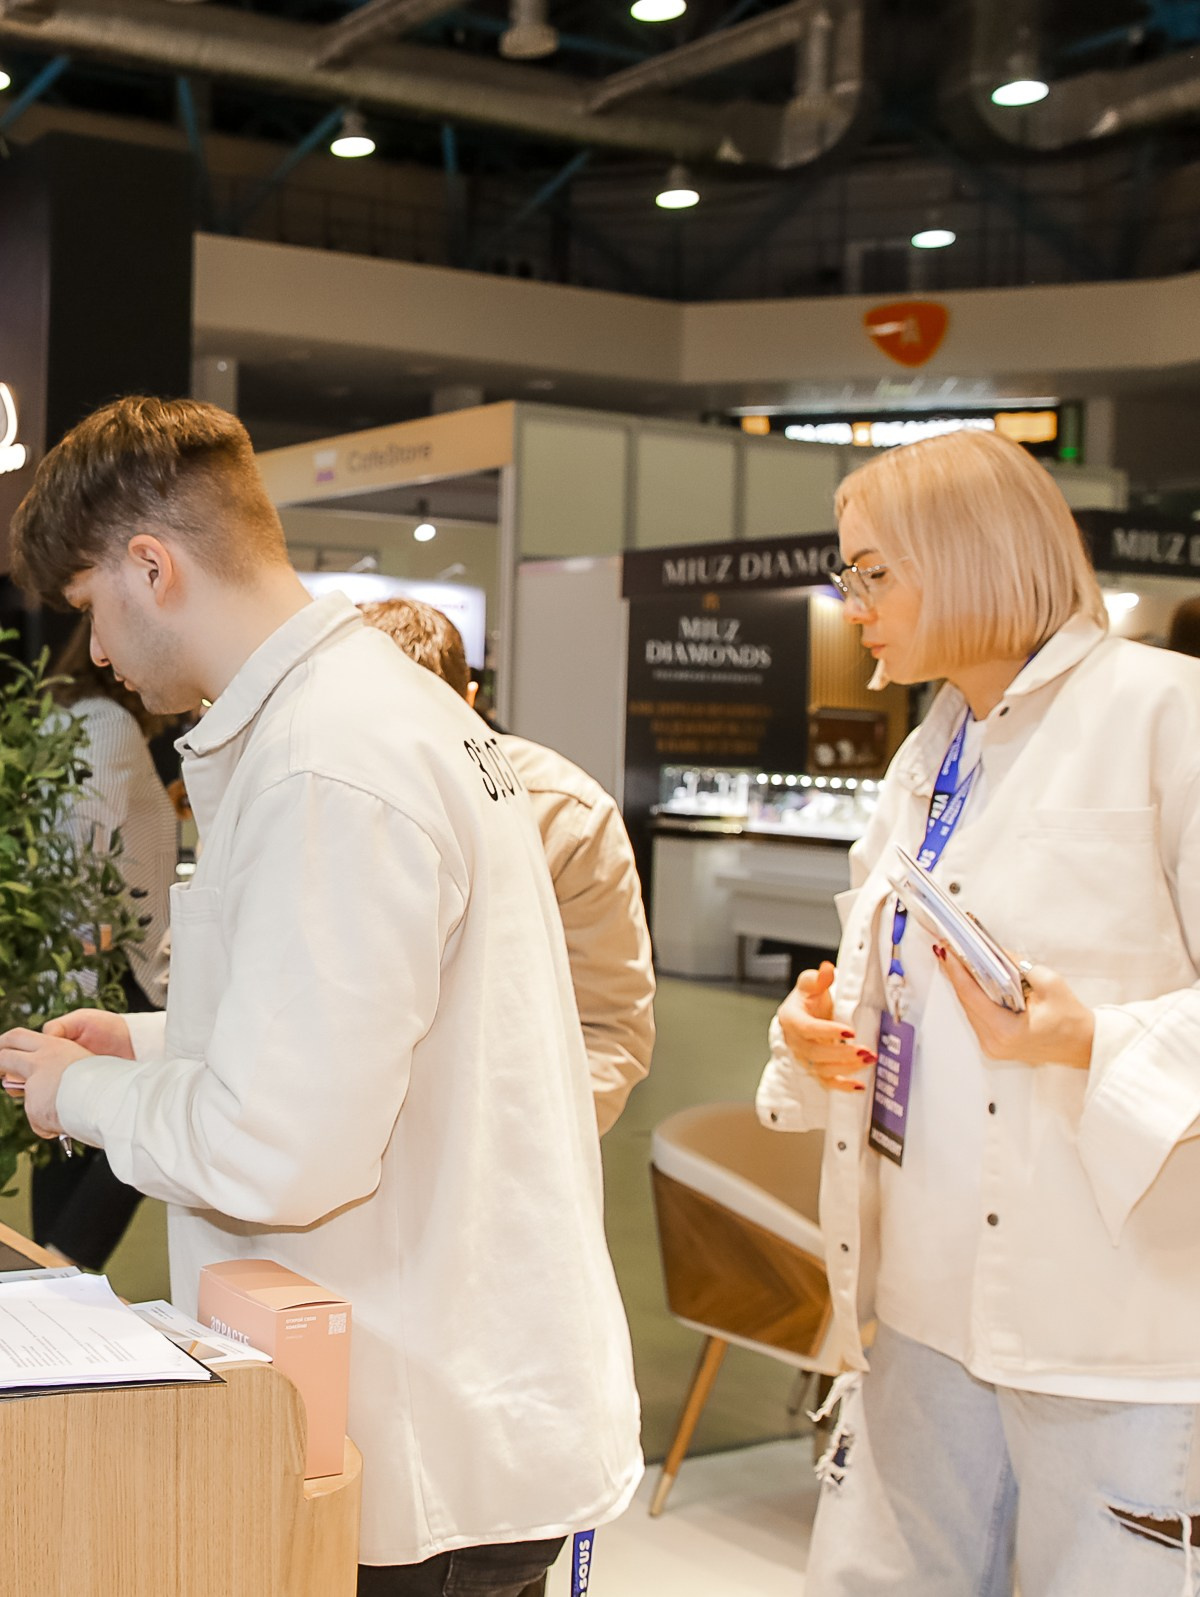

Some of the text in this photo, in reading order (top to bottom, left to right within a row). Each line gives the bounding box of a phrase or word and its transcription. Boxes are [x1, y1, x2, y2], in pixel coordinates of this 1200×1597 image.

[662, 545, 847, 586] MIUZ DIAMO
[679, 616, 740, 642] MIUZ
[645, 639, 773, 669] DIAMONDS
